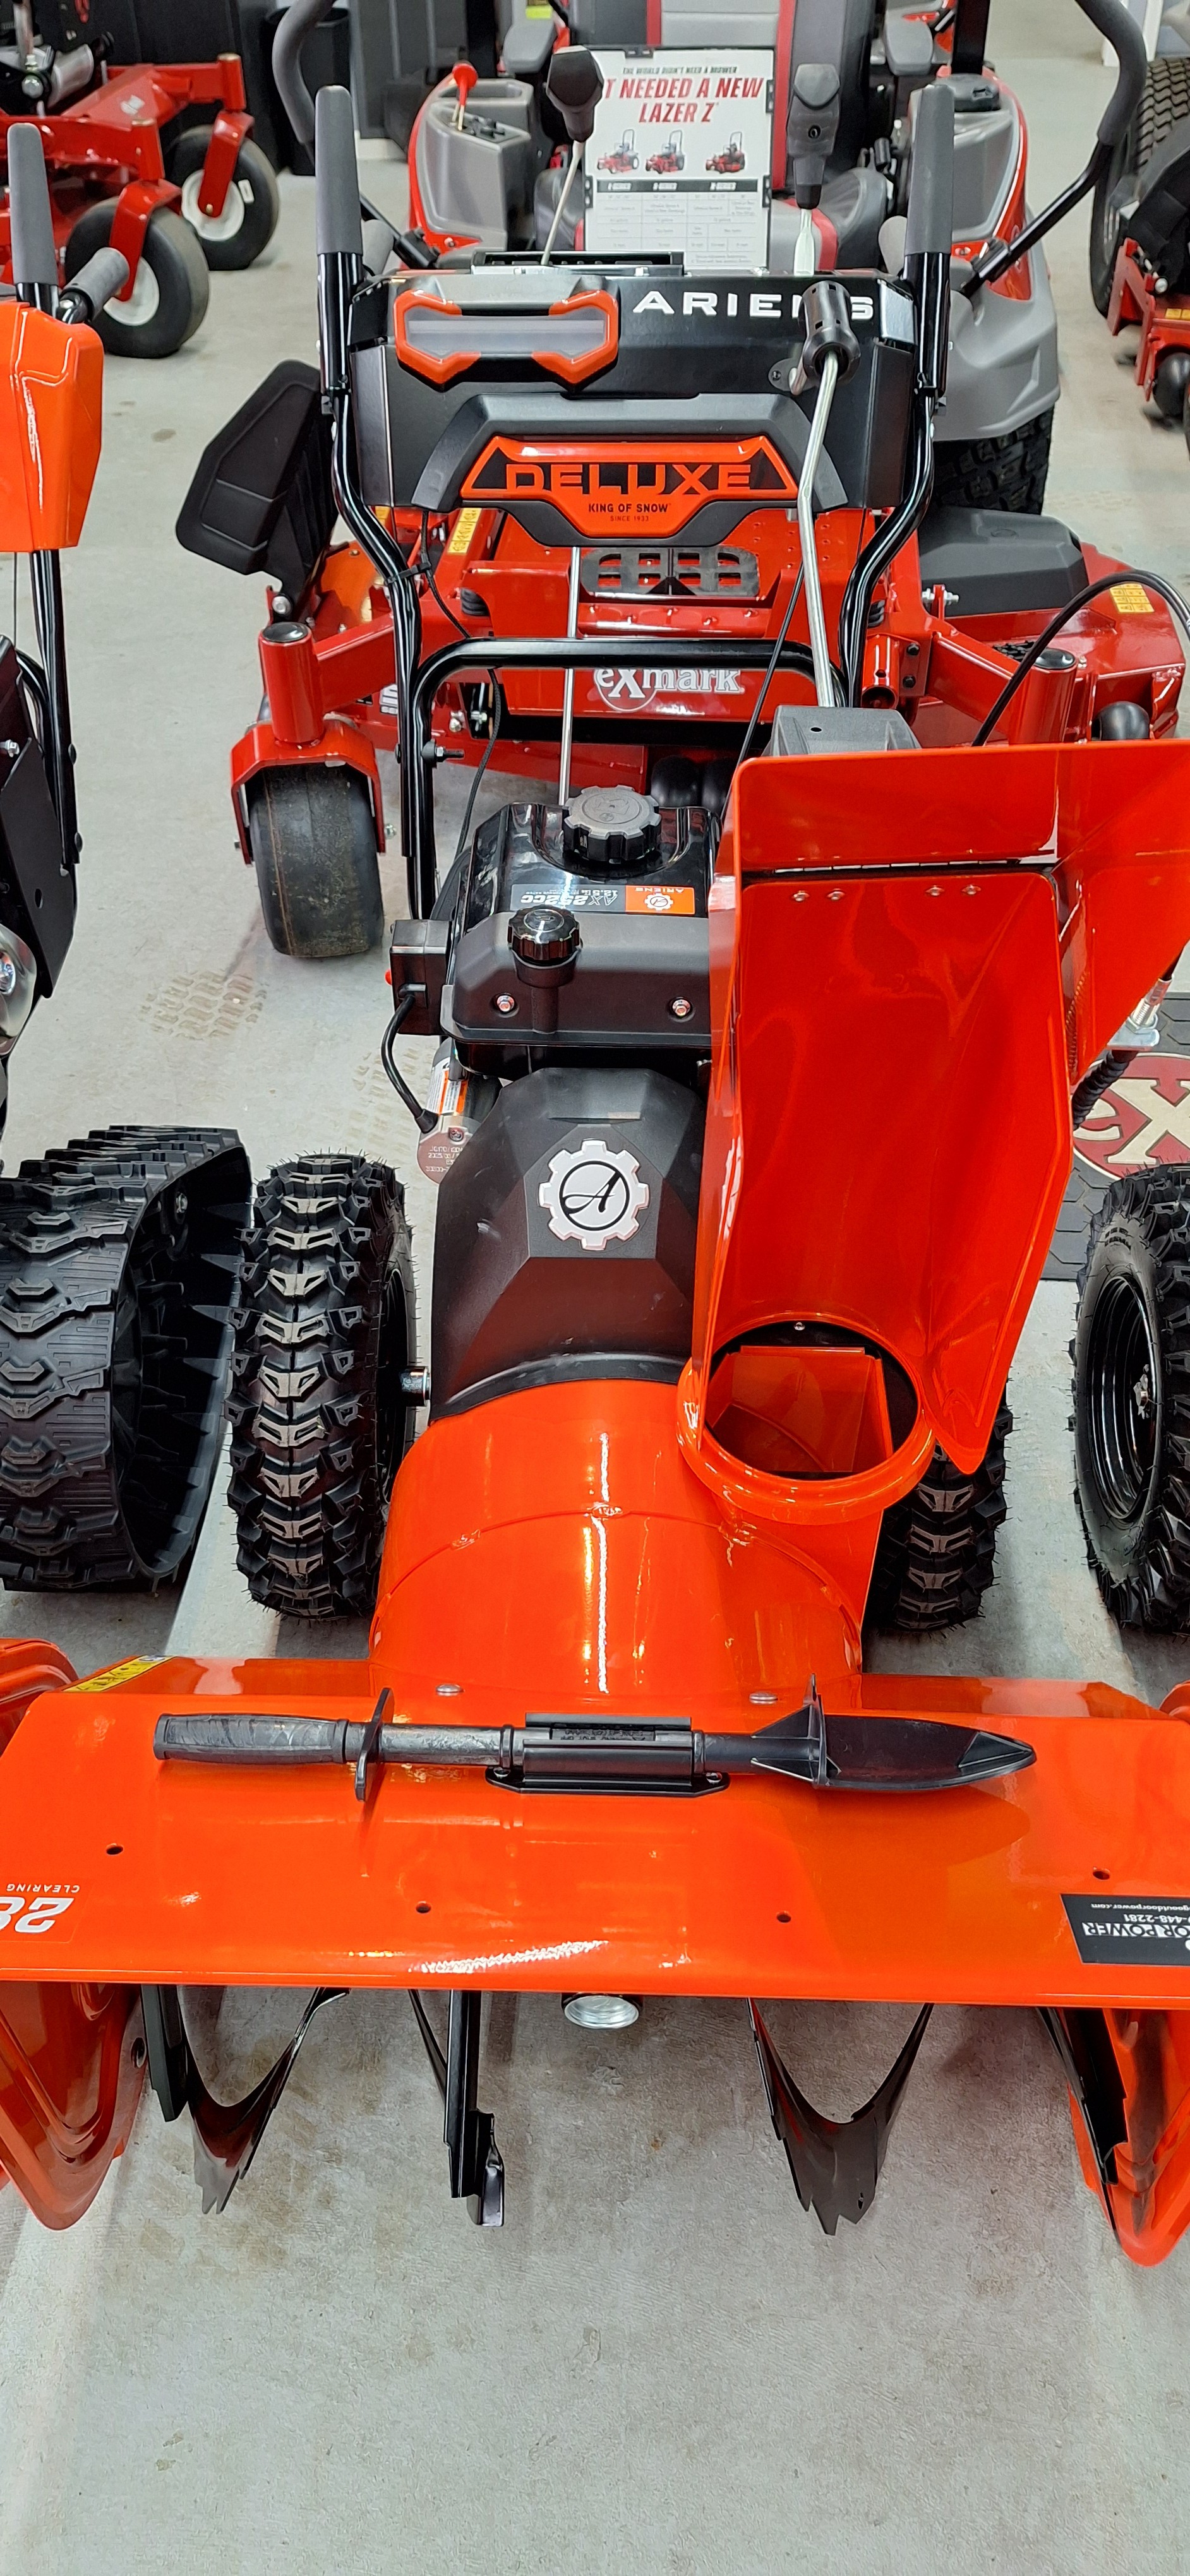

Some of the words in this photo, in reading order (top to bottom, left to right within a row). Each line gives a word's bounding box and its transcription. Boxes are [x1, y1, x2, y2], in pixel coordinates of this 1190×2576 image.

[604, 79, 616, 99] T
[619, 78, 693, 99] NEEDED
[696, 78, 711, 98] A
[714, 77, 764, 98] NEW
[639, 102, 698, 123] LAZER
[506, 464, 751, 495] DELUXE
[588, 503, 614, 513] KING
[618, 503, 632, 513] OF
[636, 503, 668, 513] SNOW
[6, 1883, 80, 1893] CLEARING
[1090, 1903, 1190, 1912] gooutdoorpower.com
